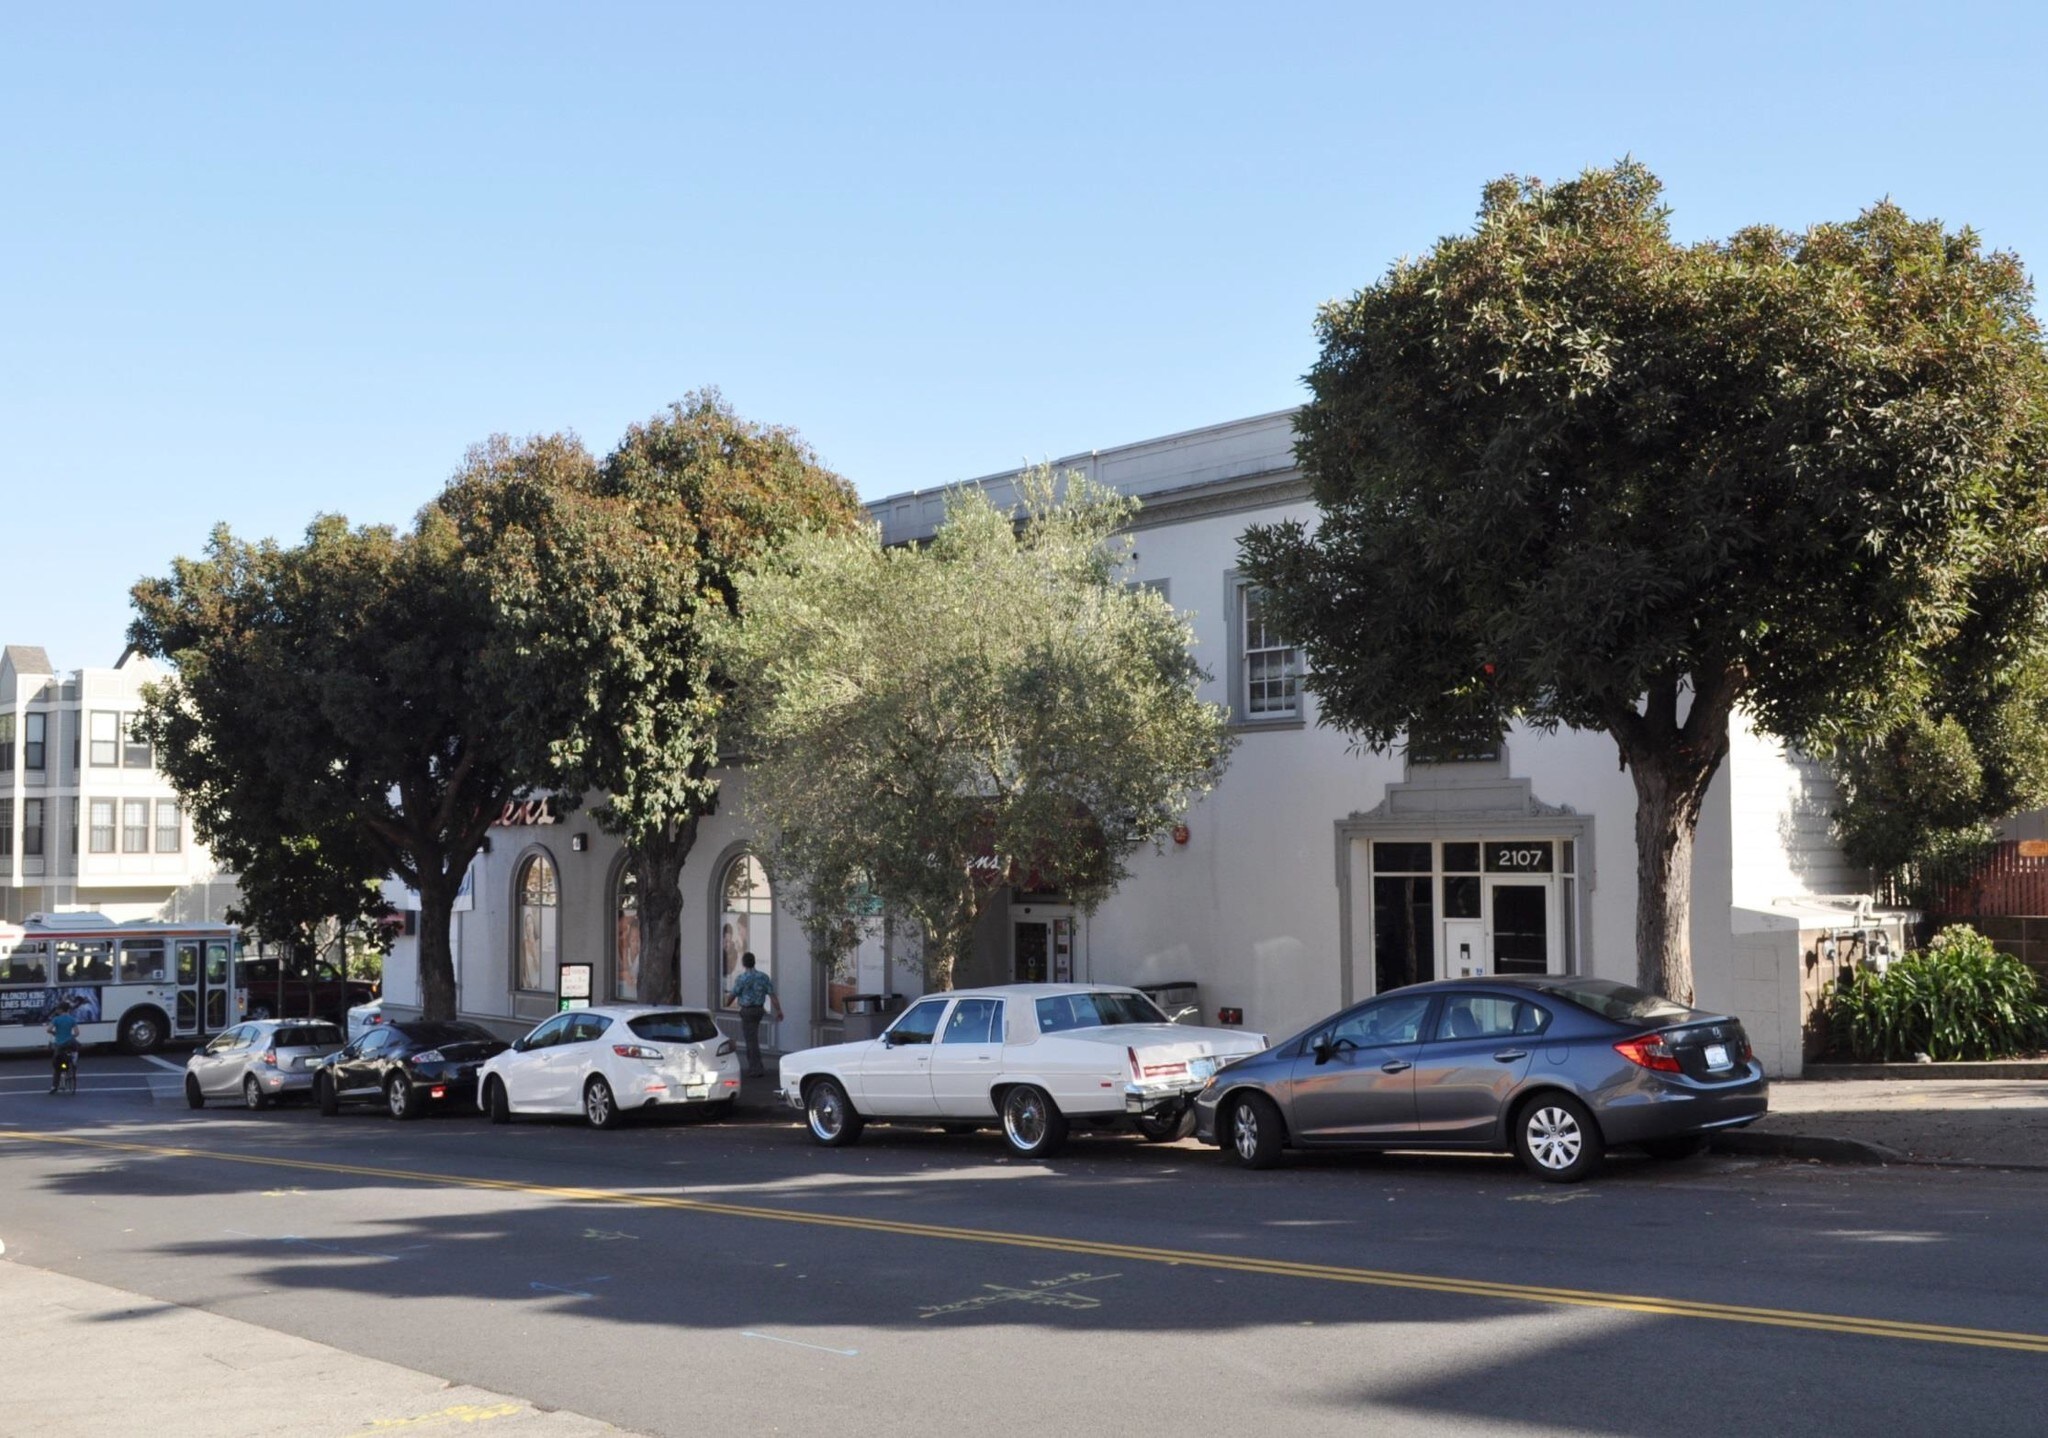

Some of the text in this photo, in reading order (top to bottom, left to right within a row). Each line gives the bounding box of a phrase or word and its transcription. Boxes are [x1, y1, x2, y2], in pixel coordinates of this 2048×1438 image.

[1499, 850, 1543, 866] 2107
[1, 991, 28, 1000] ALONZO
[20, 999, 44, 1008] BALLET
